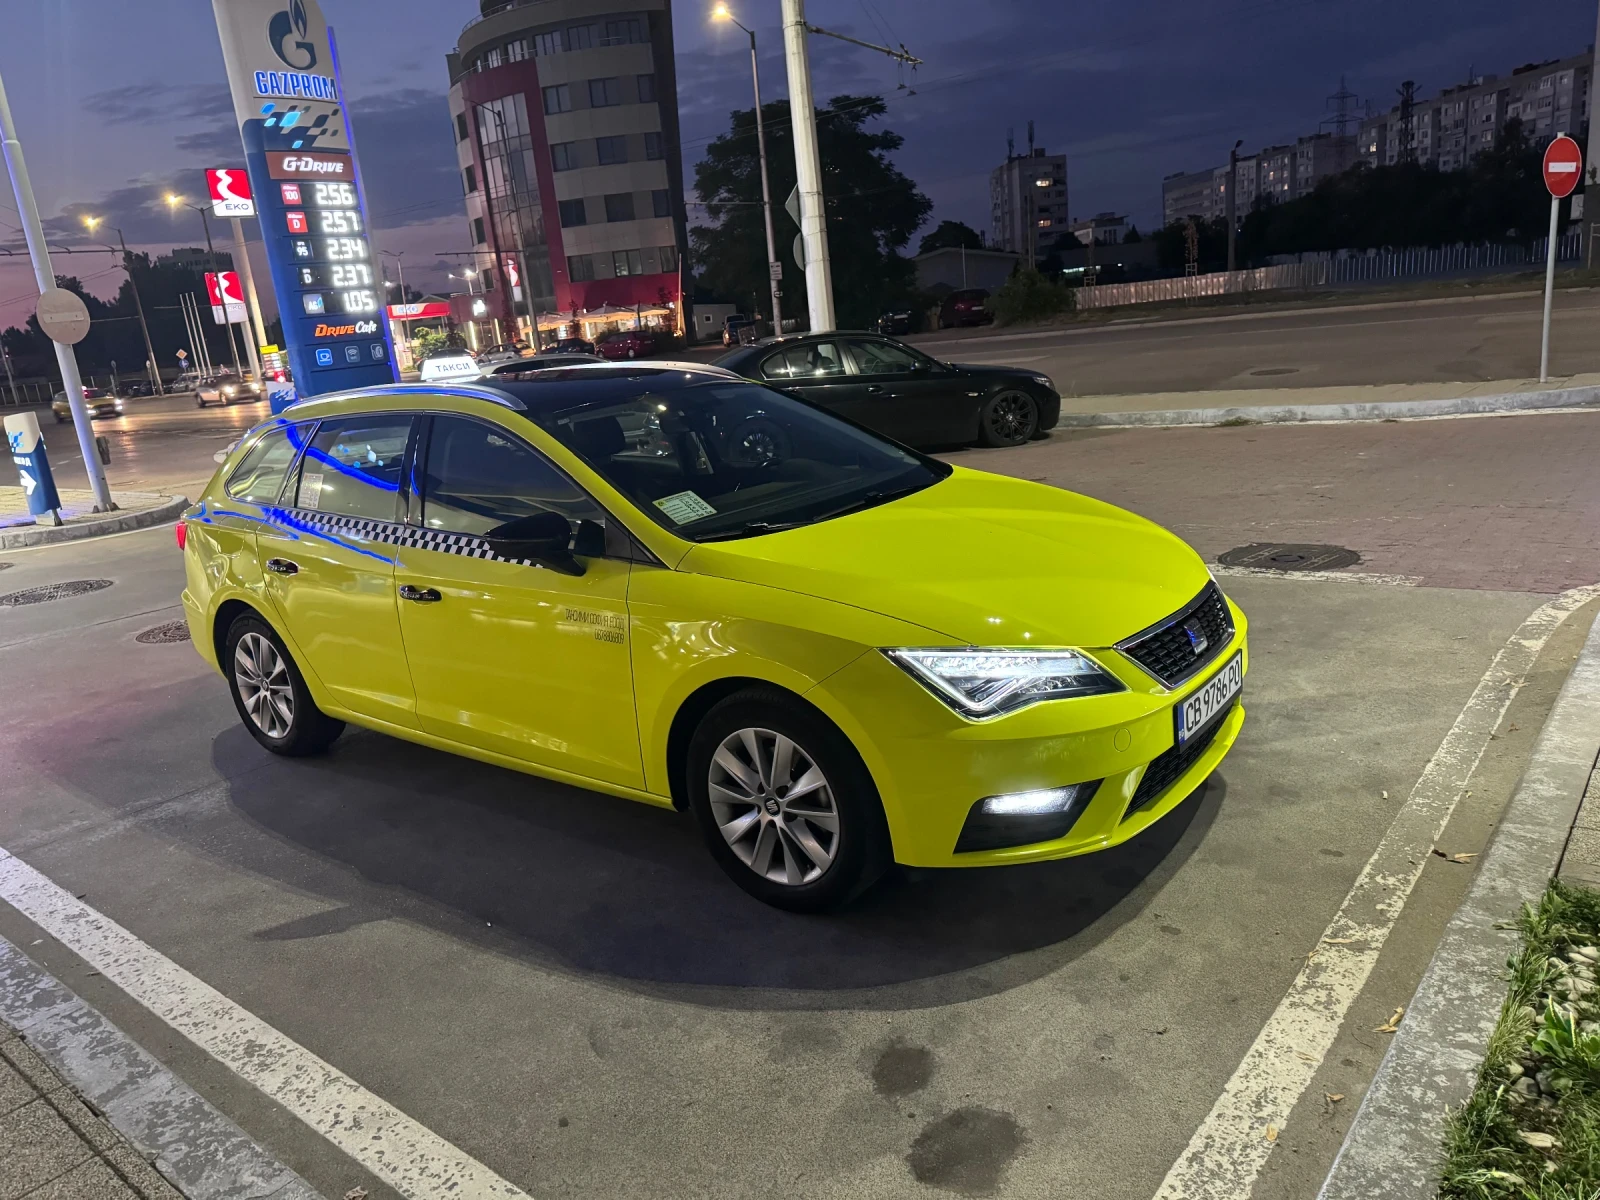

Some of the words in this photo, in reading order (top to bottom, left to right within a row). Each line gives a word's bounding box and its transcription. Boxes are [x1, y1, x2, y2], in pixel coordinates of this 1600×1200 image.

[254, 71, 338, 99] GAZPROM
[285, 191, 299, 200] 100
[315, 184, 353, 205] 2.56
[293, 219, 300, 229] D
[321, 211, 359, 232] 2.57
[296, 246, 308, 256] 95
[326, 238, 364, 259] 2.34
[304, 274, 312, 284] D
[332, 265, 370, 286] 2.37
[435, 363, 470, 372] ТАКСИ
[1186, 696, 1201, 732] CB
[1203, 671, 1228, 717] 9786
[1229, 659, 1240, 693] PO
